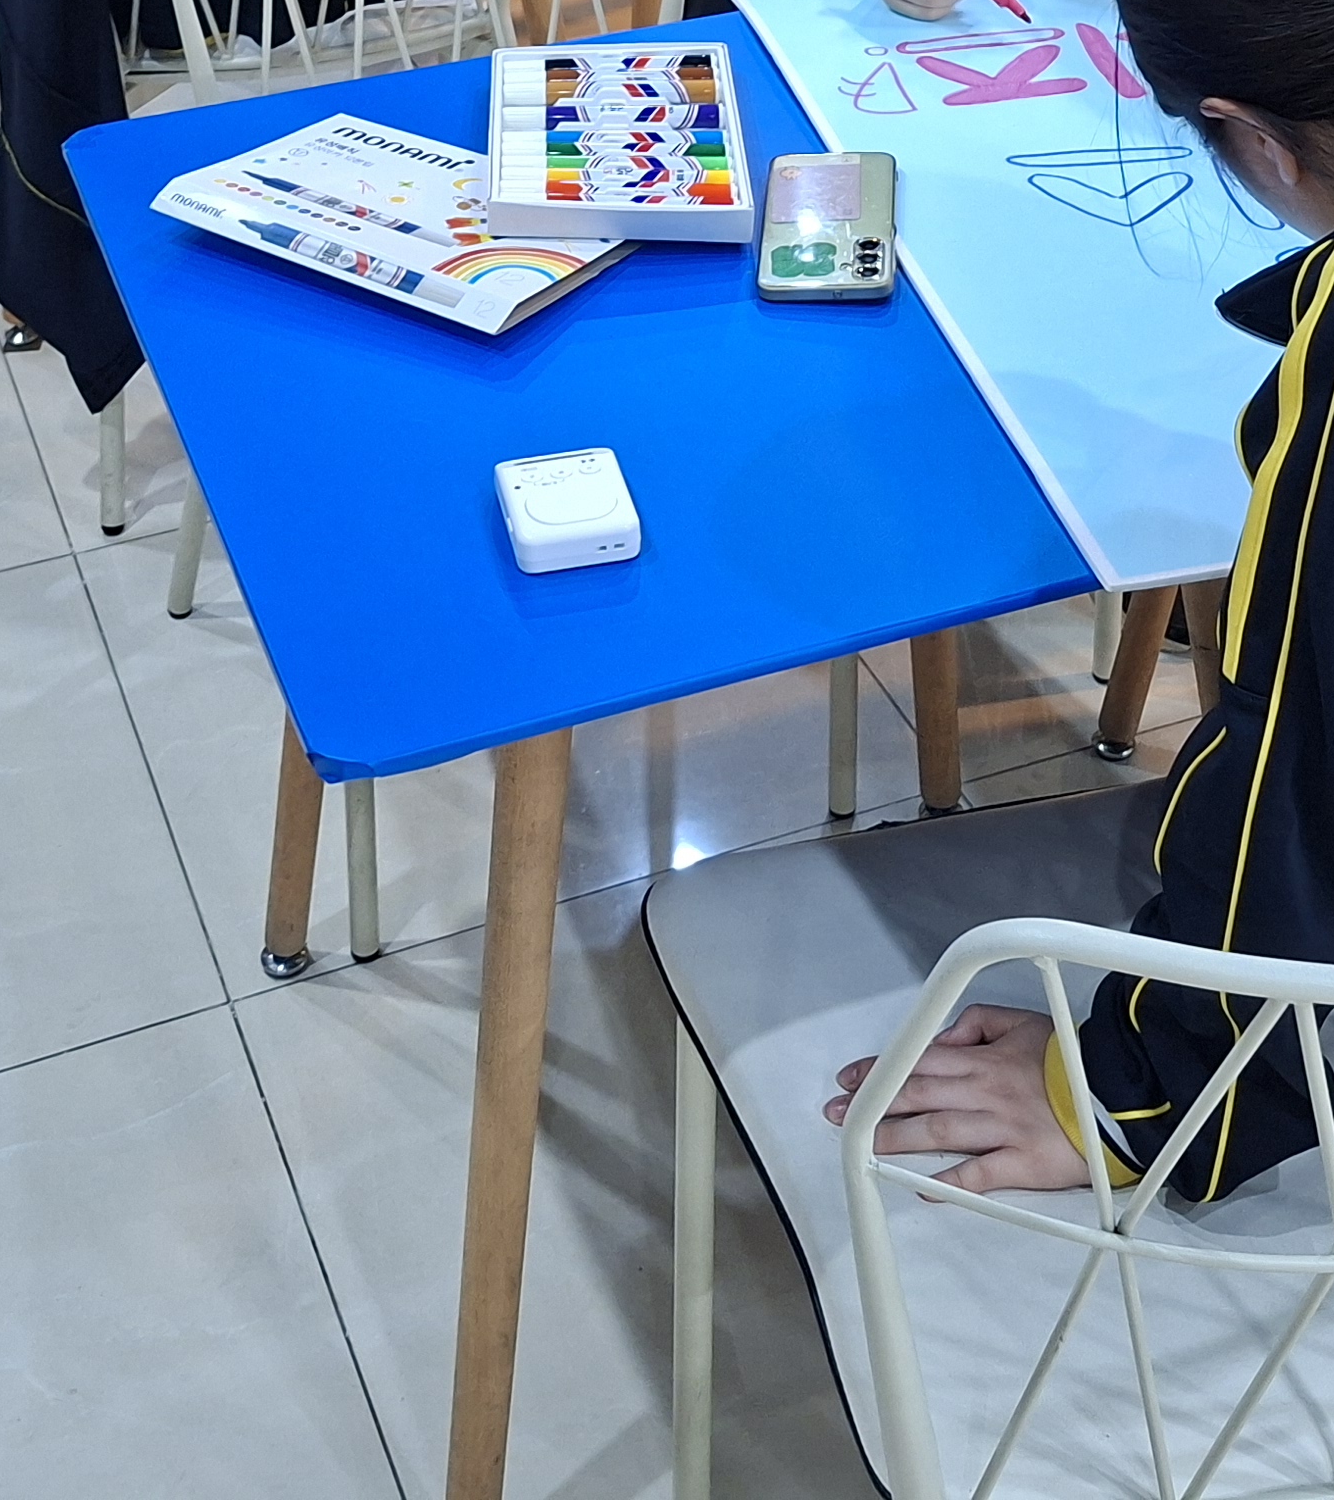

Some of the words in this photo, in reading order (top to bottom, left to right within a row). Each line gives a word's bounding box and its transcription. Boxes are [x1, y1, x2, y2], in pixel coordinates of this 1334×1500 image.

[332, 127, 475, 170] monami
[170, 193, 227, 218] monami
[473, 299, 496, 318] 12
